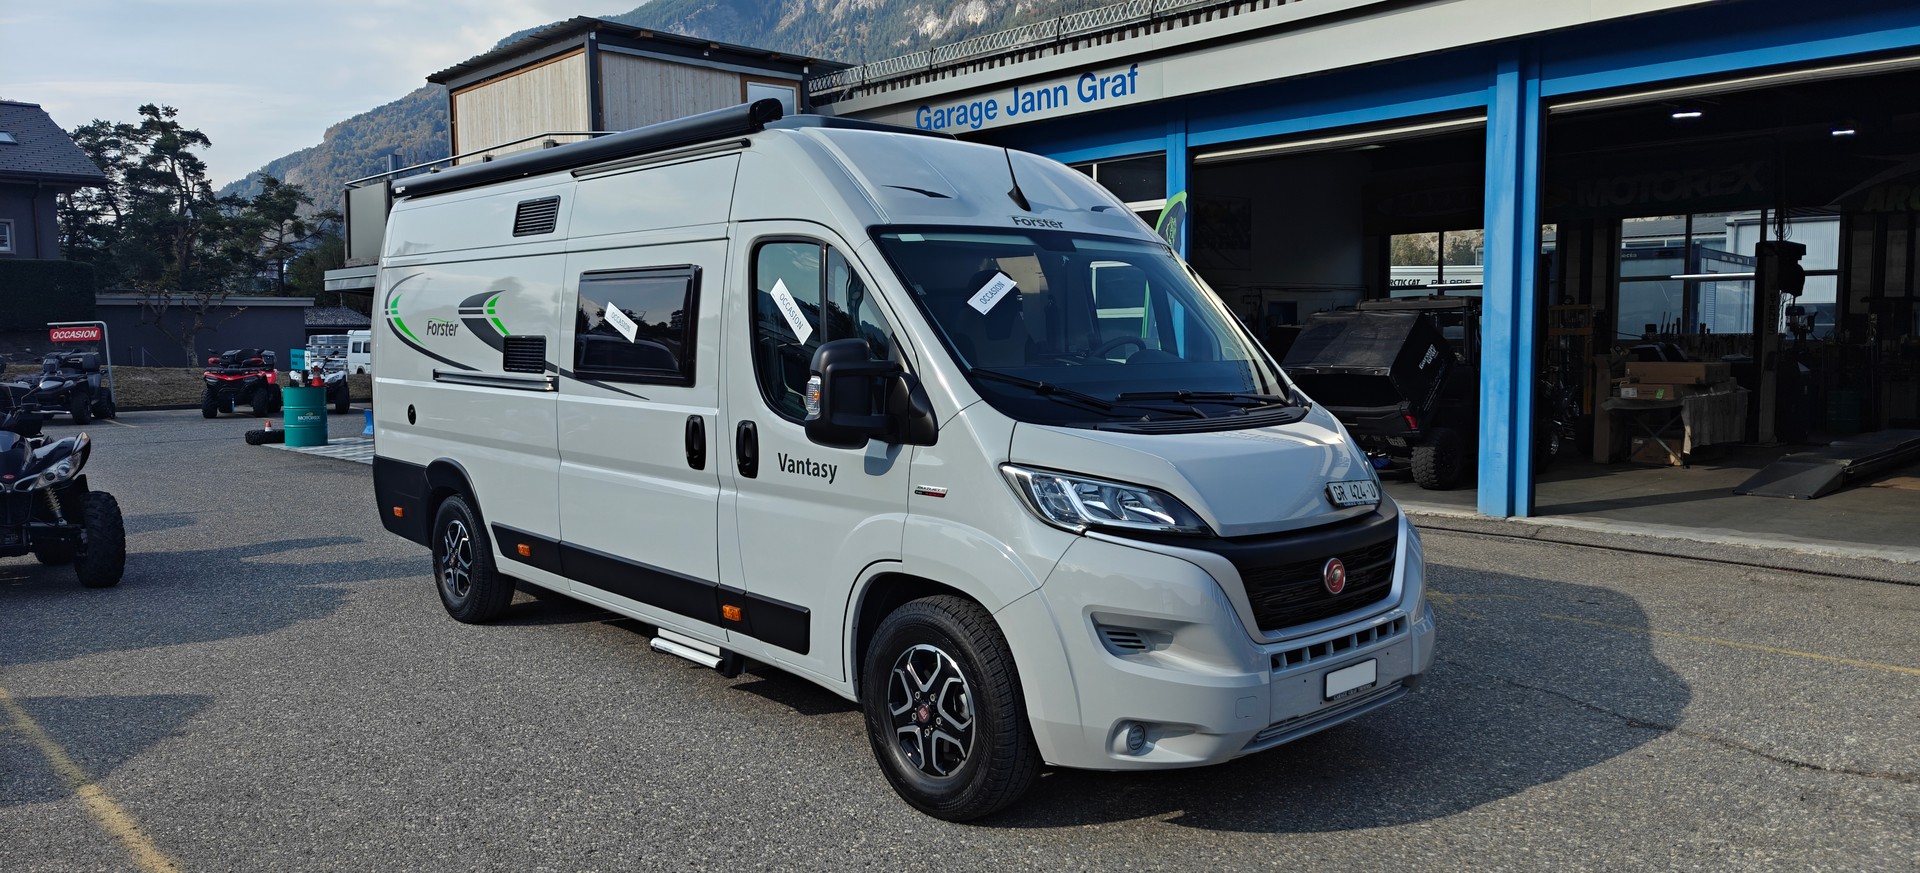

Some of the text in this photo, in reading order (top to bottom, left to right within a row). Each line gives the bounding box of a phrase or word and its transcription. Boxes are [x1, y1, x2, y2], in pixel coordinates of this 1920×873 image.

[916, 64, 1138, 130] Garage Jann Graf
[1576, 160, 1771, 208] MOTOREX
[1011, 216, 1064, 229] Forster
[979, 281, 1006, 305] OCCASION
[611, 311, 632, 333] OCCASION
[779, 292, 804, 330] OCCASION
[52, 330, 98, 340] OCCASION
[426, 320, 459, 336] Forster
[777, 452, 838, 485] Vantasy
[1333, 485, 1348, 501] GR
